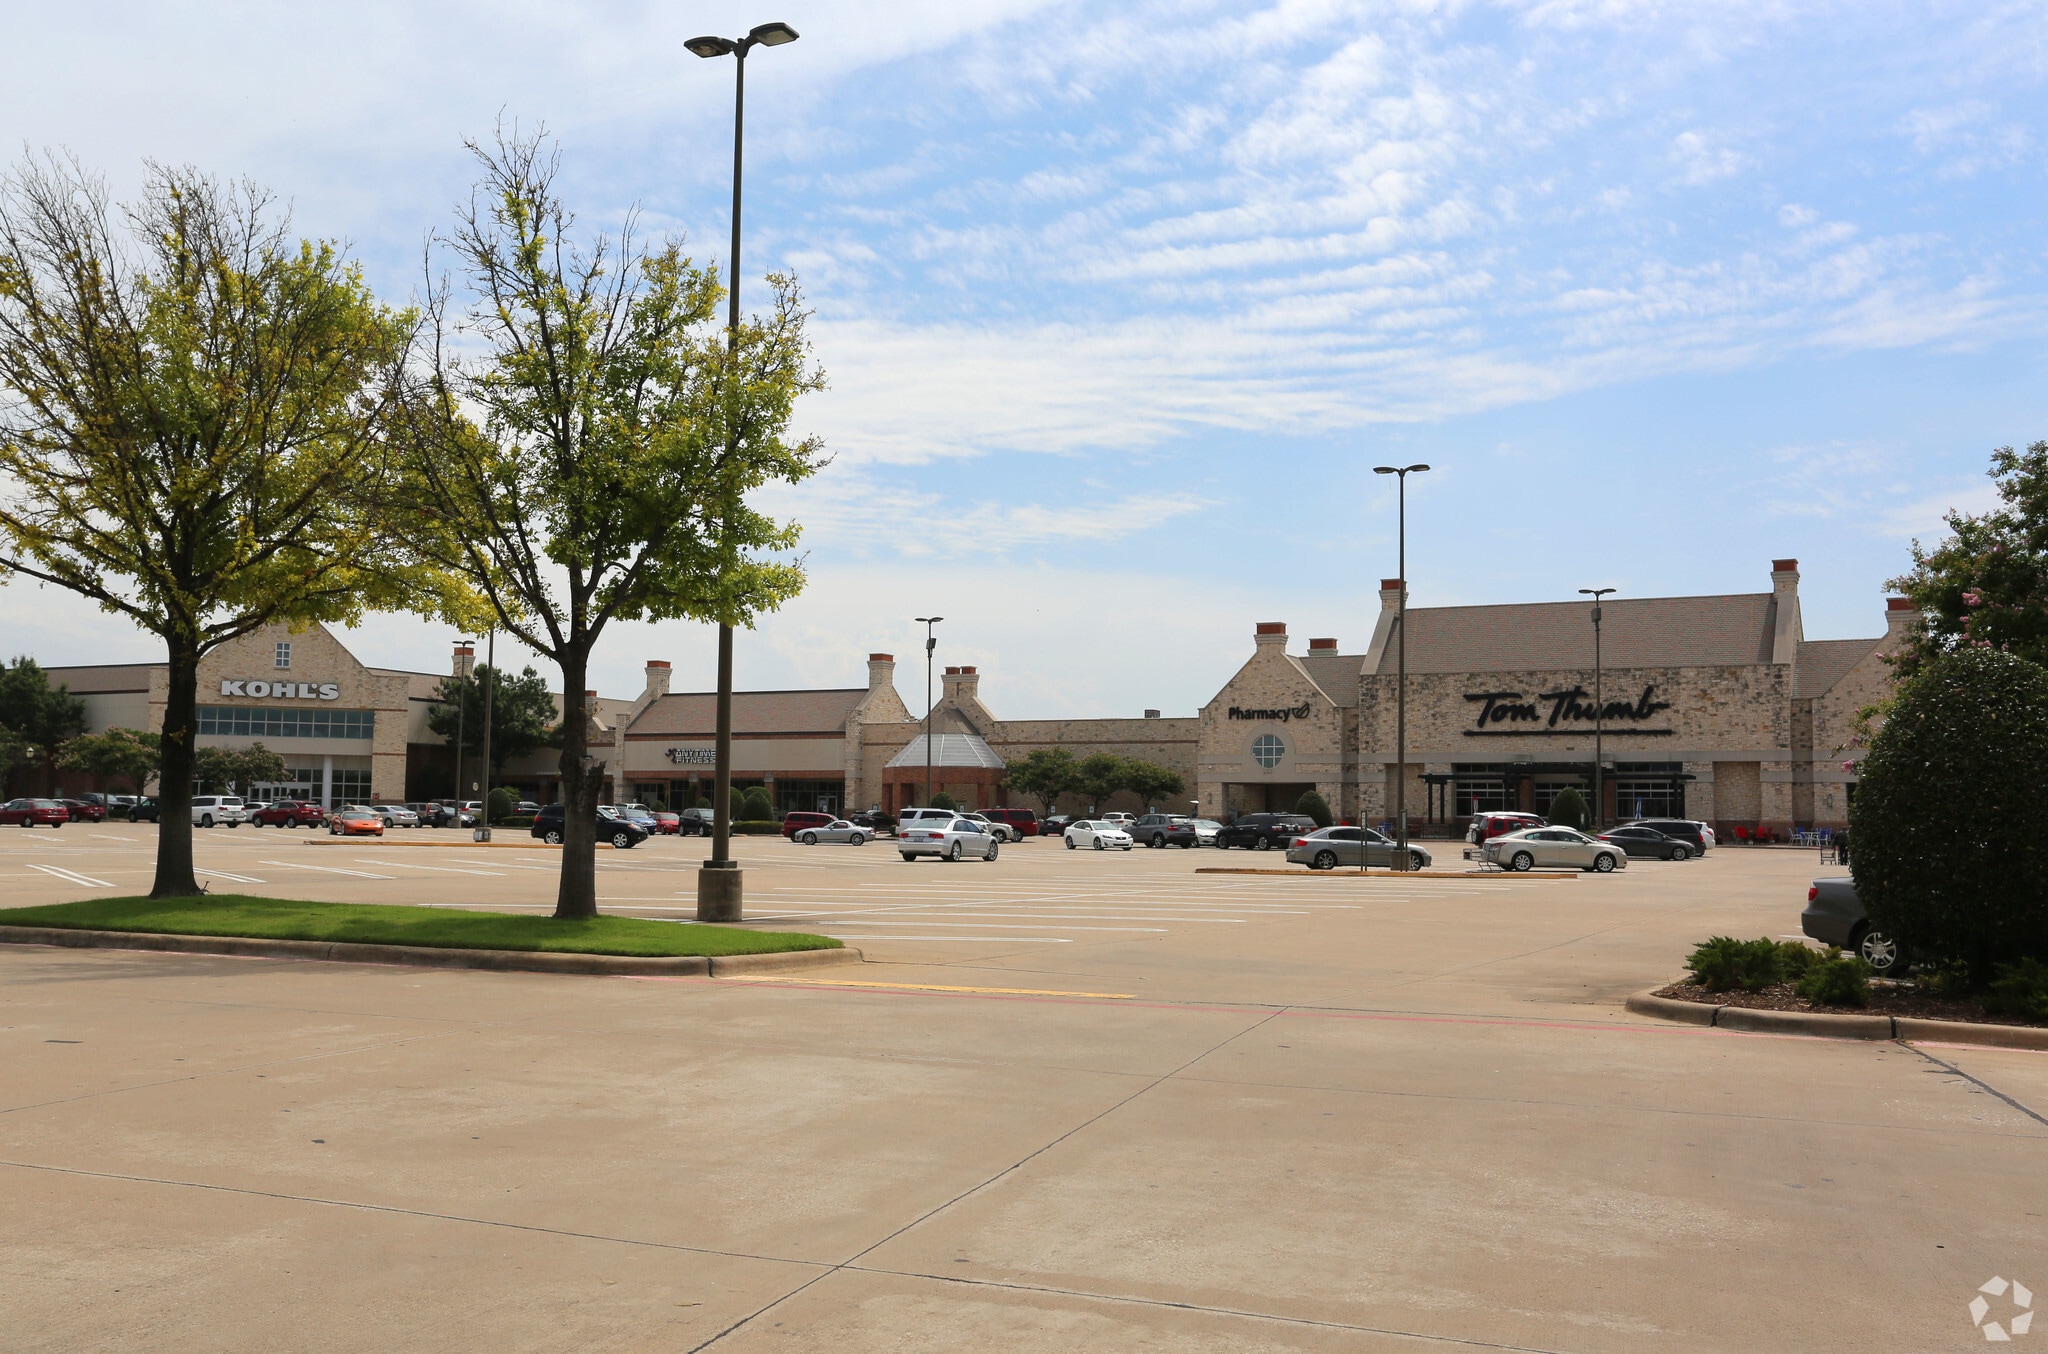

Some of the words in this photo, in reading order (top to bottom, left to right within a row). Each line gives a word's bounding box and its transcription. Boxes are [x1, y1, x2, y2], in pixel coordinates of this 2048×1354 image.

[221, 680, 340, 700] KOHL'S
[1228, 706, 1291, 722] Pharmacy
[1463, 692, 1541, 728] Tom
[1539, 685, 1670, 727] Thumb
[675, 748, 717, 757] ANYTIME
